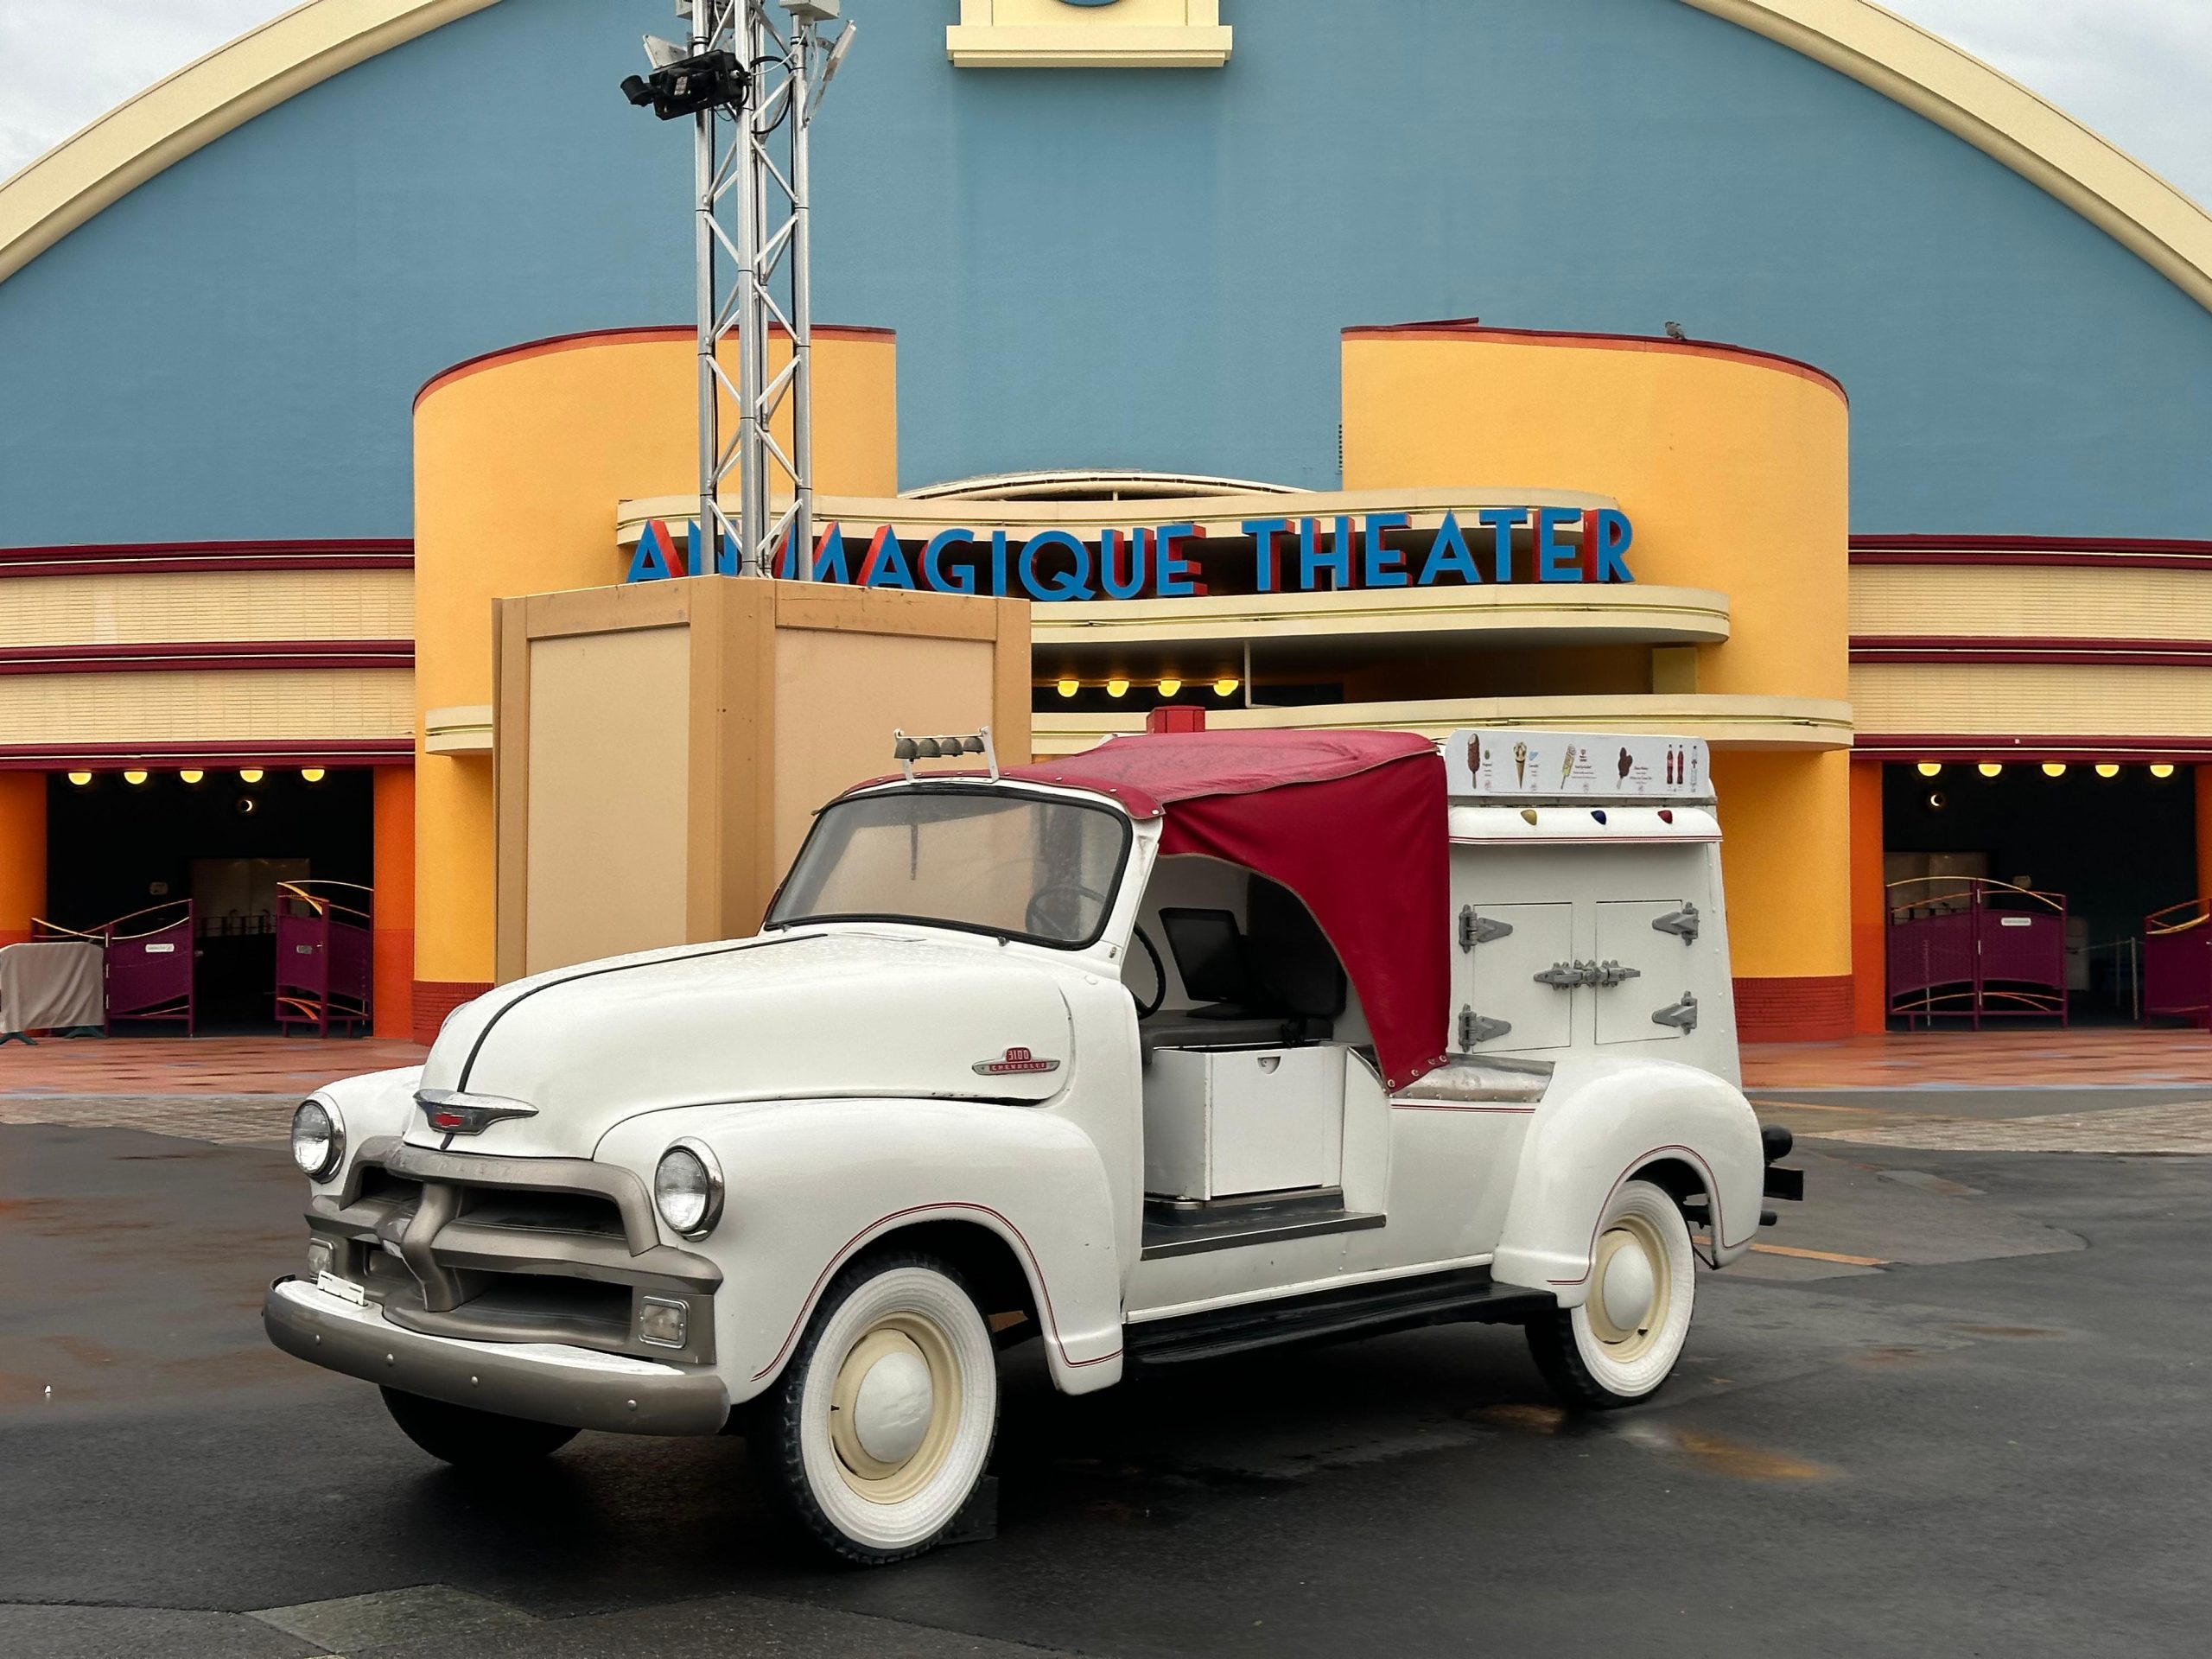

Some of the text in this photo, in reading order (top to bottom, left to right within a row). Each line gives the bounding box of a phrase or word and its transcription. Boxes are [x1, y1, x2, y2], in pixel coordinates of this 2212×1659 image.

[626, 507, 1635, 601] ANMAGIQUE THEATER
[1007, 1049, 1029, 1061] 3100
